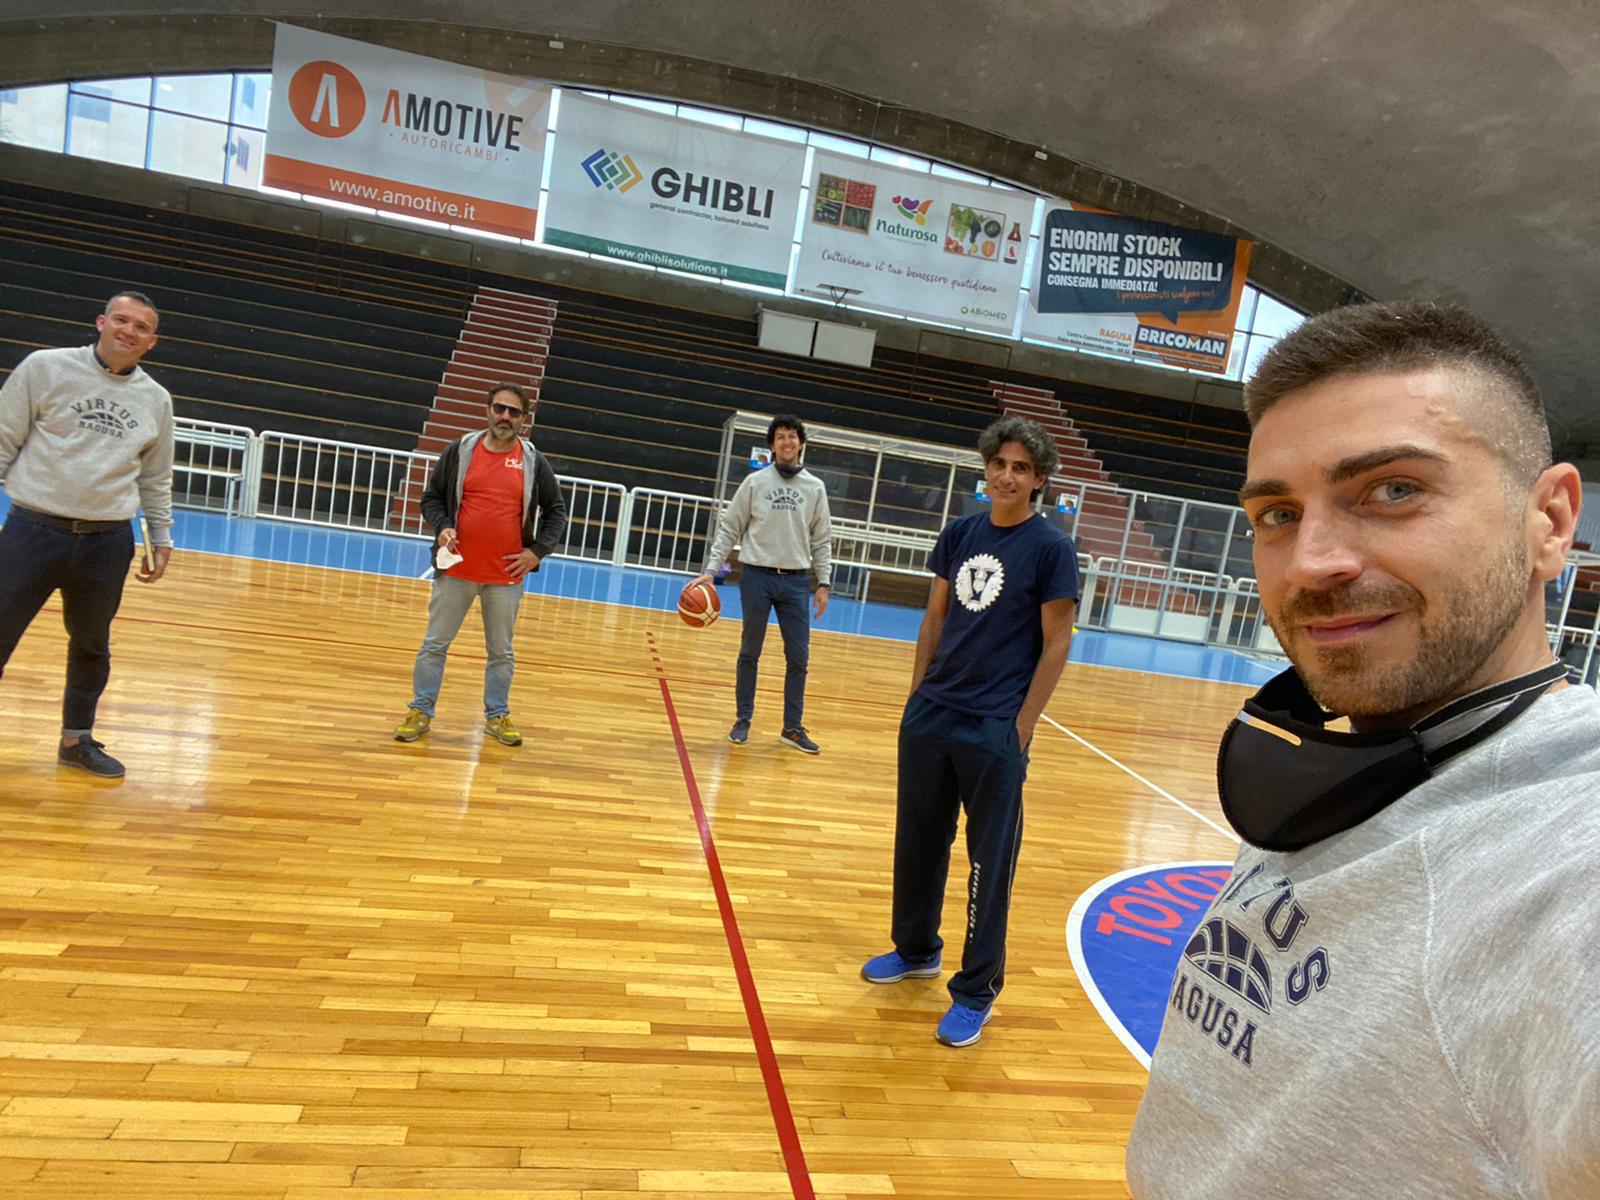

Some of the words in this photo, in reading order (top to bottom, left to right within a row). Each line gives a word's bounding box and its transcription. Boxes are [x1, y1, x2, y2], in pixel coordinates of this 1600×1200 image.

[381, 89, 524, 152] AMOTIVE
[401, 132, 498, 161] AUTORICAMBI
[329, 178, 476, 221] www.amotive.it
[651, 167, 775, 219] GHIBLI
[1049, 228, 1119, 253] ENORMI
[1122, 234, 1183, 258] STOCK
[607, 245, 728, 278] www.ghiblisolutions.it
[821, 248, 871, 268] Coltiviamo
[874, 260, 885, 271] il
[887, 263, 903, 275] tuo
[906, 267, 949, 285] benessere
[950, 278, 998, 294] quotidiano
[1048, 252, 1120, 277] SEMPRE
[1123, 257, 1224, 282] DISPONIBILI
[1047, 274, 1099, 289] CONSEGNA
[1101, 279, 1158, 293] IMMEDIATA!
[969, 307, 1008, 320] ABIOMED
[1099, 328, 1132, 340] RAGUSA
[1138, 327, 1225, 356] BRICOMAN
[71, 398, 139, 429] VIRTUS
[79, 420, 123, 439] RAGUSA
[1170, 970, 1257, 1068] AGUSA
